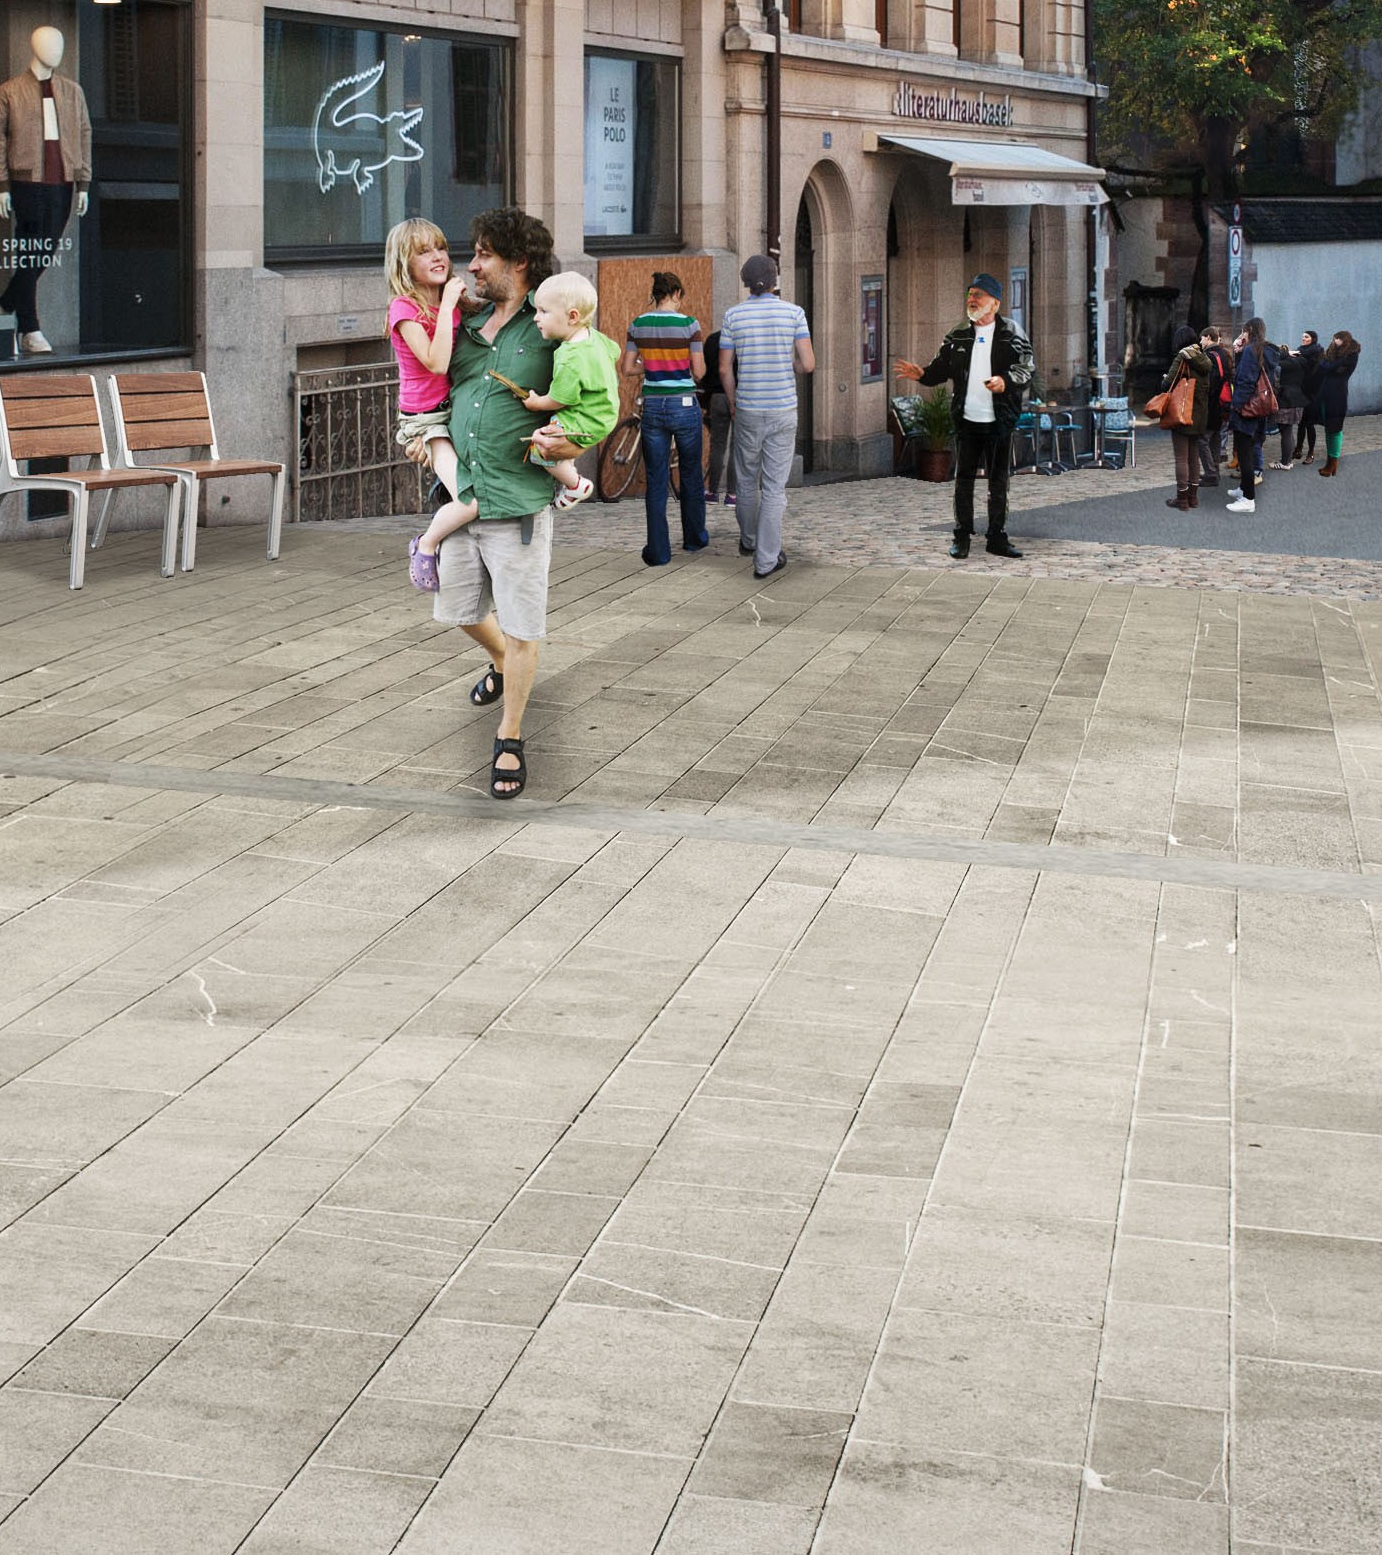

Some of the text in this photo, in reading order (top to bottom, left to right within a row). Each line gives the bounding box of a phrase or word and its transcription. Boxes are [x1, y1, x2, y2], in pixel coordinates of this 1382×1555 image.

[610, 87, 619, 102] LE
[603, 106, 626, 123] PARIS
[603, 126, 626, 143] POLO
[2, 238, 52, 252] SPRING
[57, 237, 72, 250] 19
